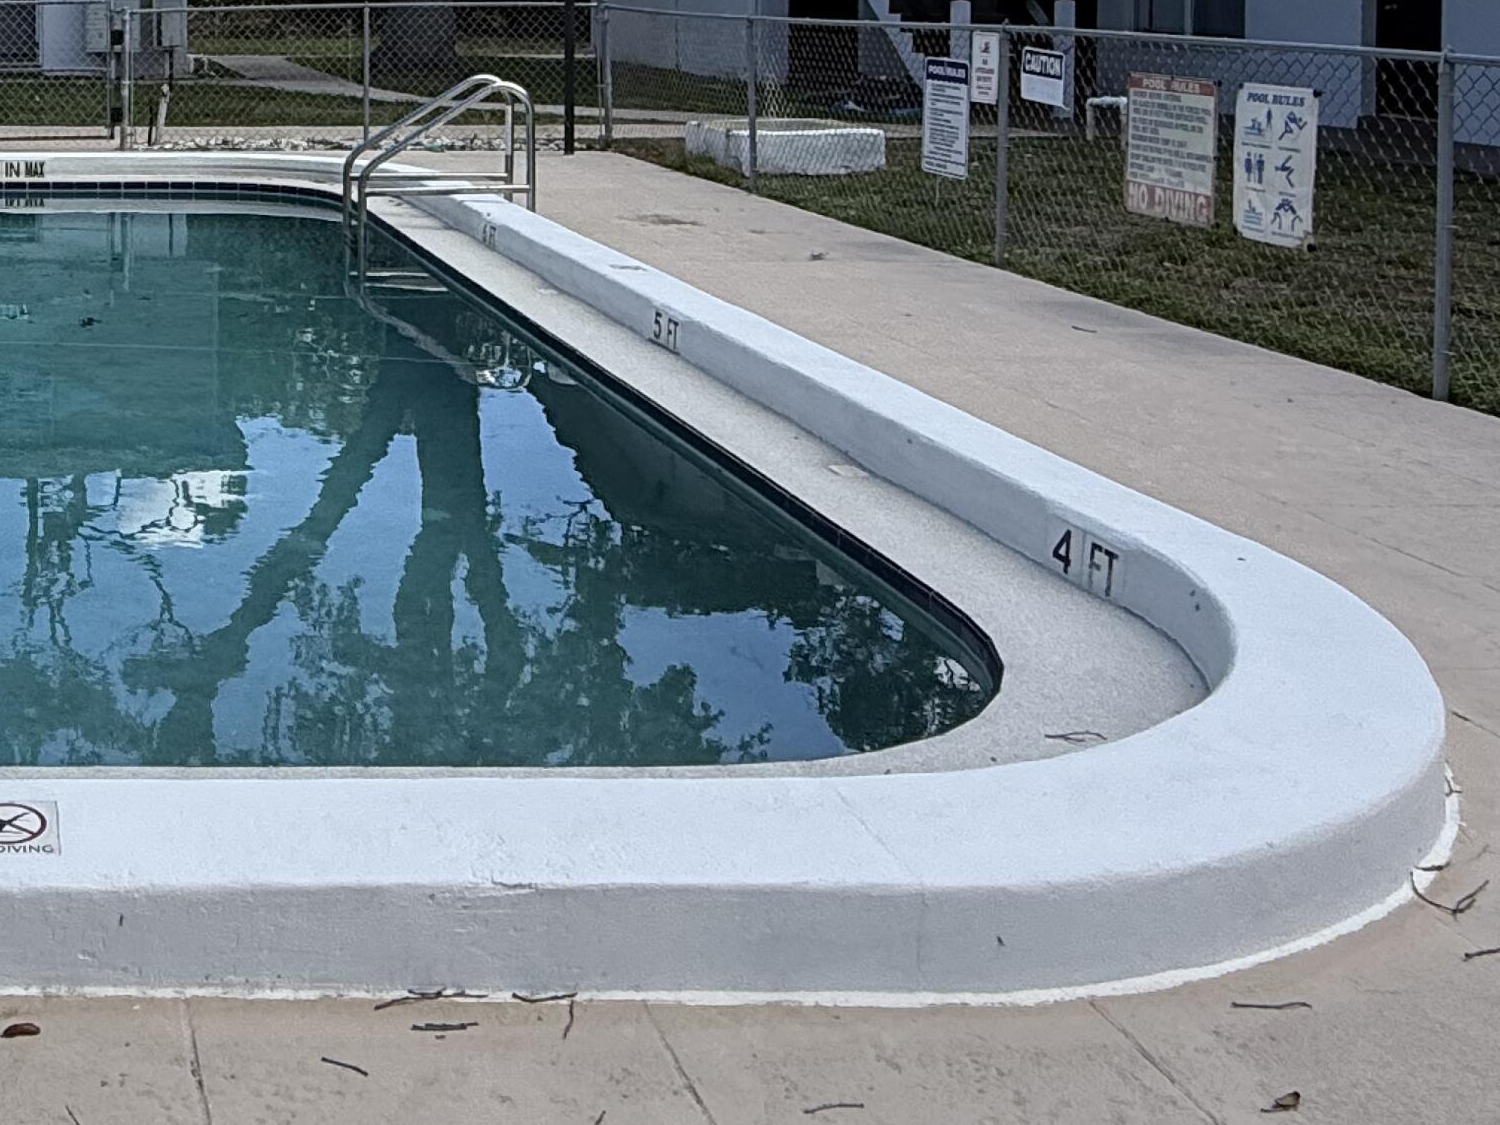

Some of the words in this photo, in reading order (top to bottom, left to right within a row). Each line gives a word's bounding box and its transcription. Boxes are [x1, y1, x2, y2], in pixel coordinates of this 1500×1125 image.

[928, 65, 945, 75] POOL
[1025, 52, 1061, 76] CAUTION
[1142, 78, 1166, 92] POOL
[1247, 92, 1269, 104] POOL
[1272, 95, 1305, 107] RULES
[4, 161, 20, 178] IN
[24, 161, 45, 178] MAX
[1128, 182, 1149, 210] NO
[1154, 187, 1209, 224] DIVING
[653, 311, 663, 340] 5
[666, 317, 680, 351] FT
[1052, 529, 1072, 575] 4
[1087, 542, 1119, 597] FT
